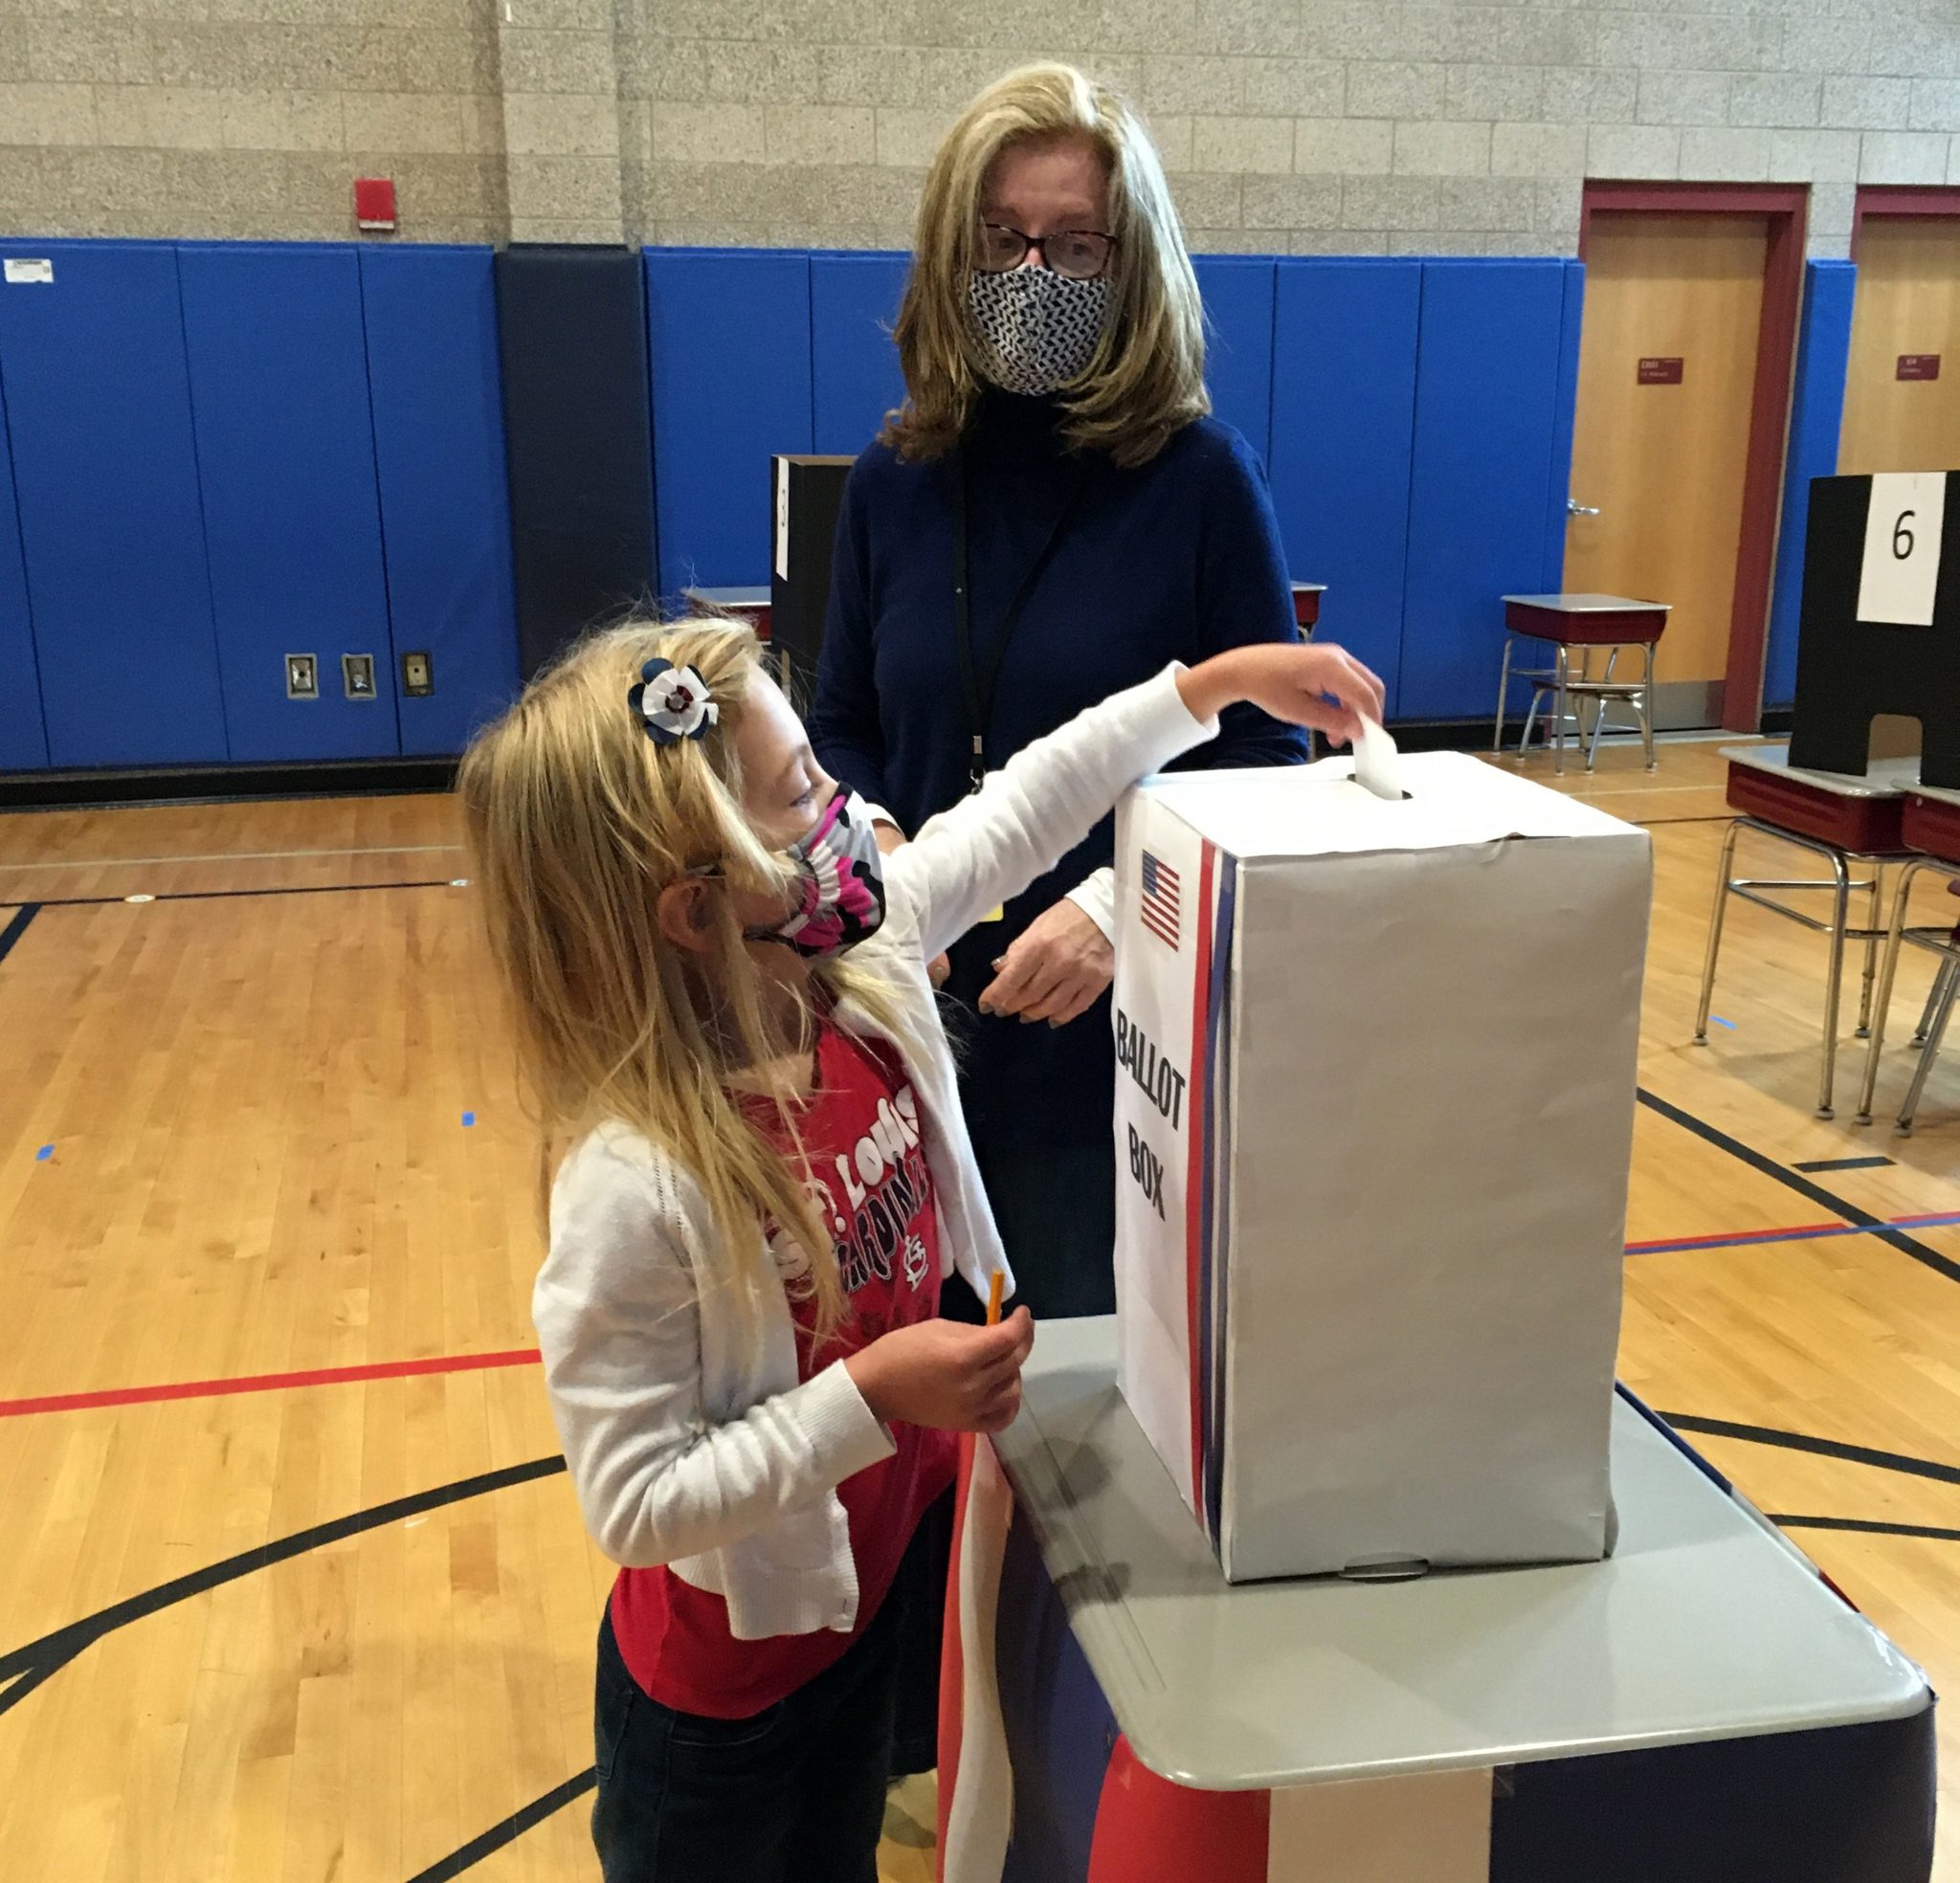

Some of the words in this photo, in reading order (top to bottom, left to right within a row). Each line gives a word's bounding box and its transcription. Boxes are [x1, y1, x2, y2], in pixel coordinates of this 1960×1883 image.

[1893, 510, 1916, 561] 6
[1117, 1008, 1186, 1132] BALLOT
[1127, 1120, 1166, 1222] BOX
